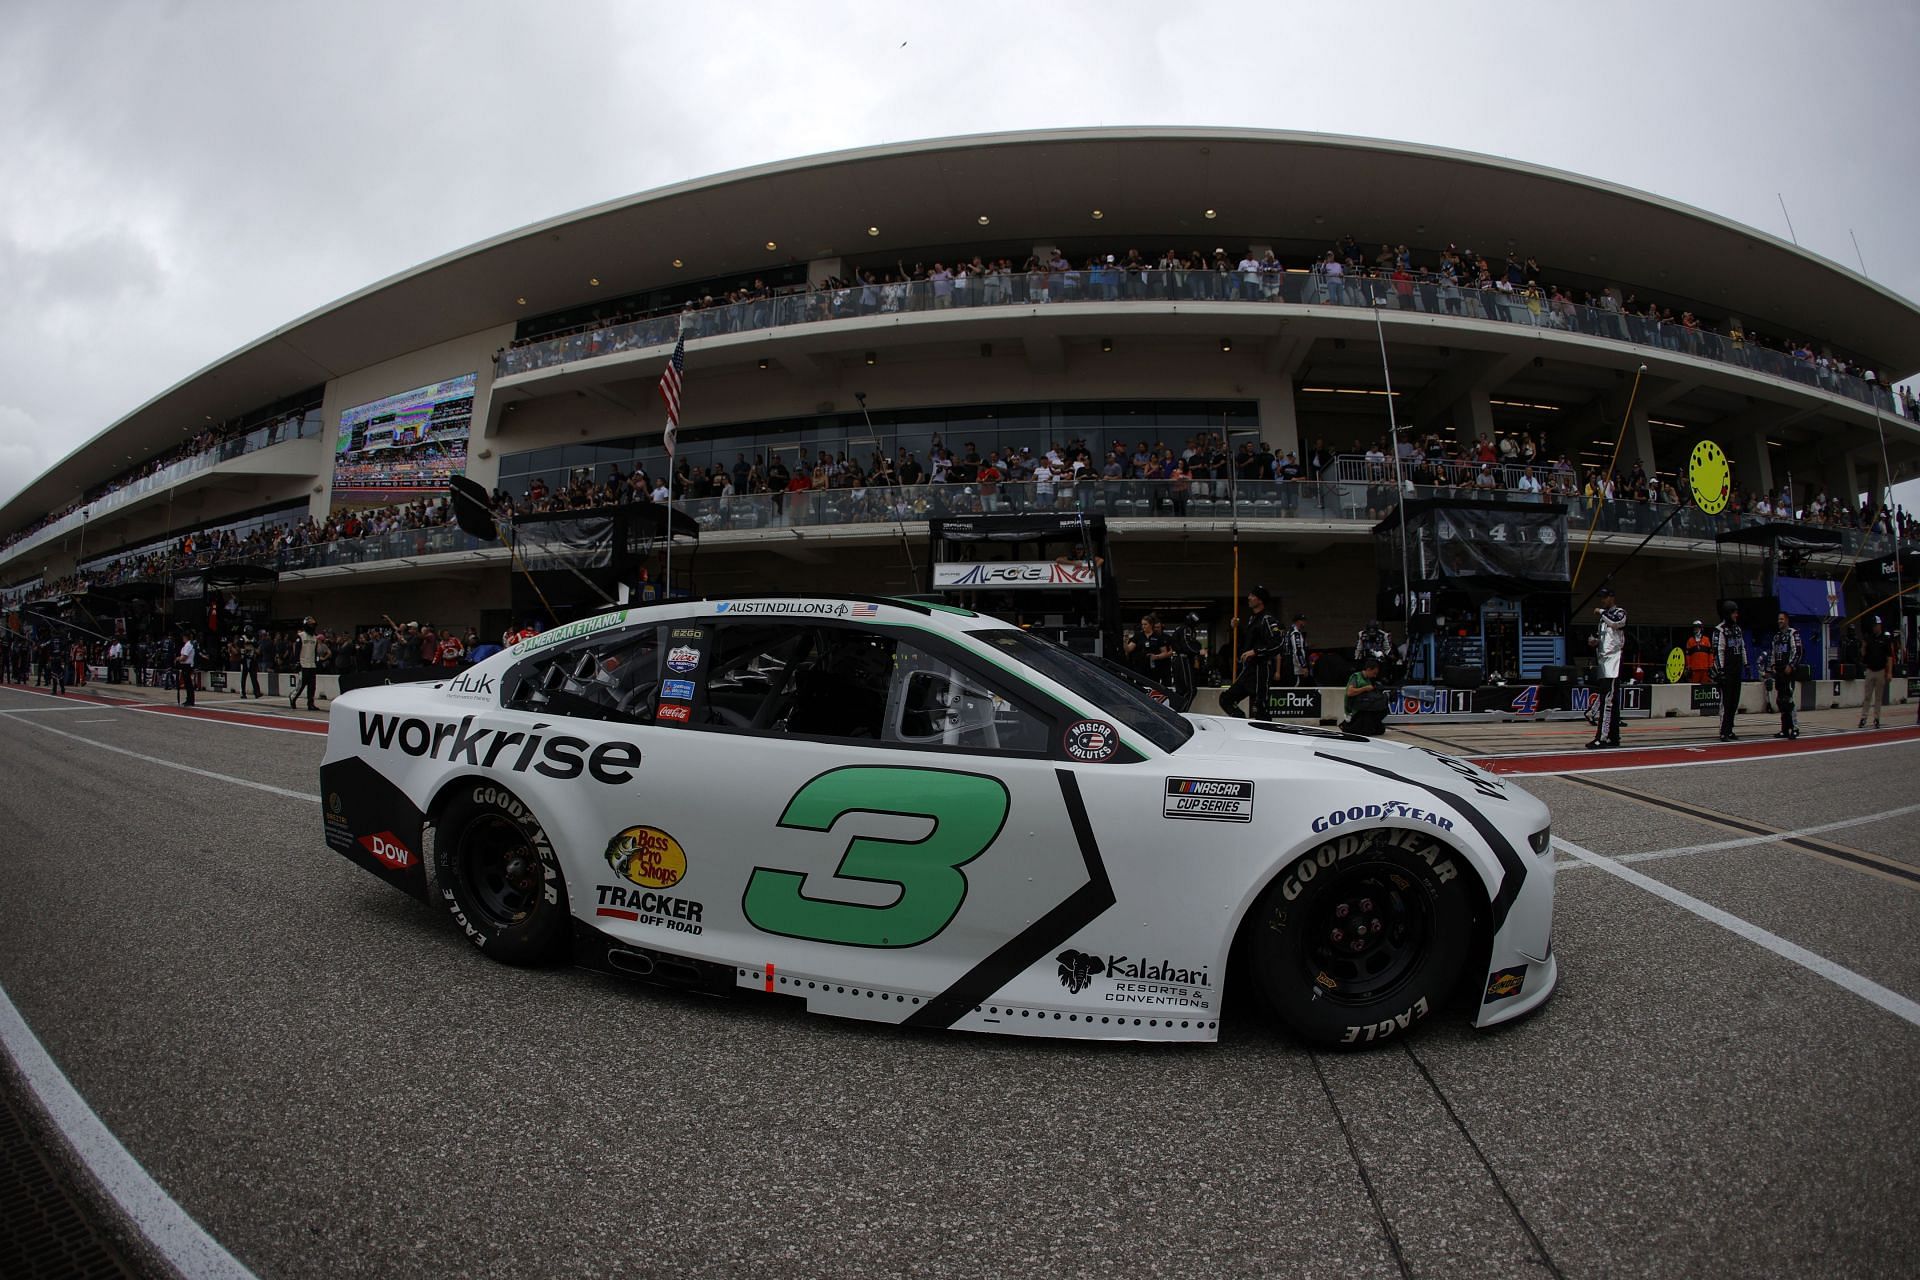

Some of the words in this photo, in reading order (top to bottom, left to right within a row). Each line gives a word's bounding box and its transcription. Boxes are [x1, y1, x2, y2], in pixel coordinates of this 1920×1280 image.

[1489, 523, 1506, 541] 4
[728, 603, 833, 614] AUSTINDILLON3
[526, 625, 576, 650] AMERICAN
[575, 611, 623, 634] ETHANOL
[1269, 692, 1314, 707] hoPark
[1511, 685, 1541, 716] 4
[1694, 687, 1720, 700] EchoPa
[1072, 723, 1111, 737] NASCAR
[358, 711, 642, 785] workrise
[1070, 745, 1112, 759] SALUTES
[1194, 782, 1241, 796] NASCAR
[1176, 798, 1200, 810] CUP
[1200, 800, 1240, 812] SERIES
[638, 830, 669, 851] Bass
[640, 847, 662, 865] Pro
[741, 764, 1012, 949] 3
[638, 861, 678, 884] Shops
[596, 885, 703, 923] TRACKER
[442, 888, 488, 948] EAGLE
[640, 915, 664, 926] OFF
[666, 919, 702, 936] ROAD
[1106, 955, 1208, 986] Kalahari
[1105, 993, 1209, 1009] CONVENTIONS
[1116, 984, 1188, 996] RESORTS
[1192, 990, 1203, 999] &
[1339, 995, 1430, 1043] EAGLE
